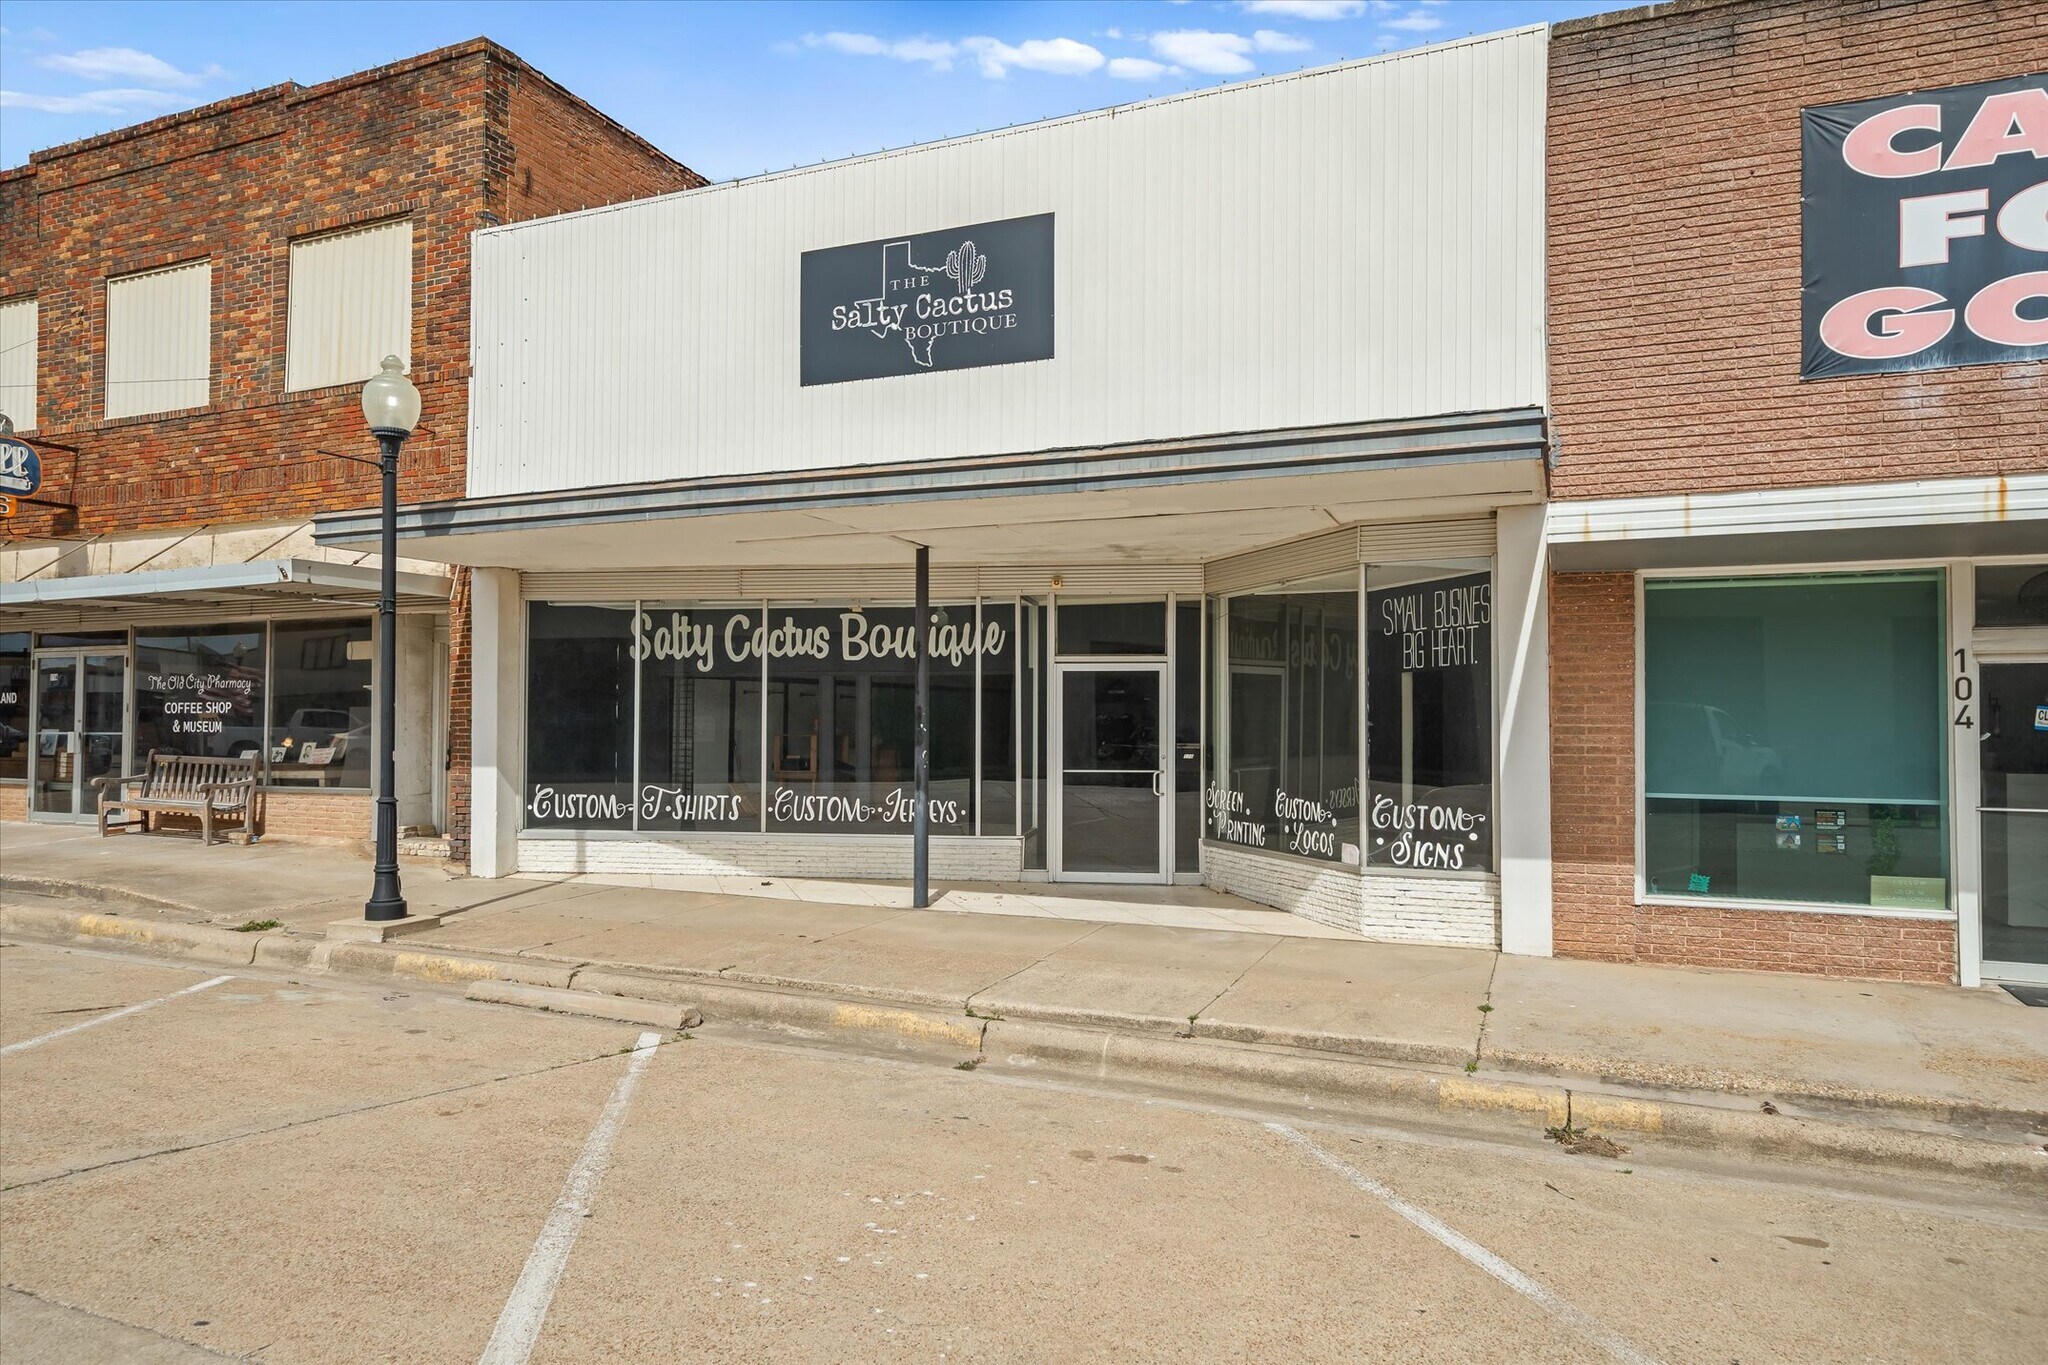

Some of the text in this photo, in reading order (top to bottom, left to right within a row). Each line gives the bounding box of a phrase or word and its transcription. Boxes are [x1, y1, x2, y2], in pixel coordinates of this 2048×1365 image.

[890, 276, 930, 291] THE
[832, 288, 1013, 331] Salty Cactus
[905, 313, 1017, 340] BOUTIQUE
[1382, 594, 1427, 636] SMALL
[629, 612, 1006, 672] Salty Cactus Bouique
[1403, 631, 1424, 669] BIG
[0, 692, 17, 704] AND
[148, 673, 251, 694] The Old City Pharmacy
[1954, 648, 1974, 729] 104
[164, 701, 232, 714] COFFEE SHOP
[172, 719, 222, 733] & MUSEUM
[533, 784, 633, 819] CUSTOM
[774, 786, 957, 823] CUSTOM JEREYS
[1205, 780, 1243, 813] SCREEN
[1275, 788, 1332, 822] CUSTOM
[1372, 794, 1486, 831] CUSTOM
[1213, 809, 1265, 846] PRINTING
[1290, 822, 1335, 857] LOGOS
[1390, 832, 1464, 870] SIGNS
